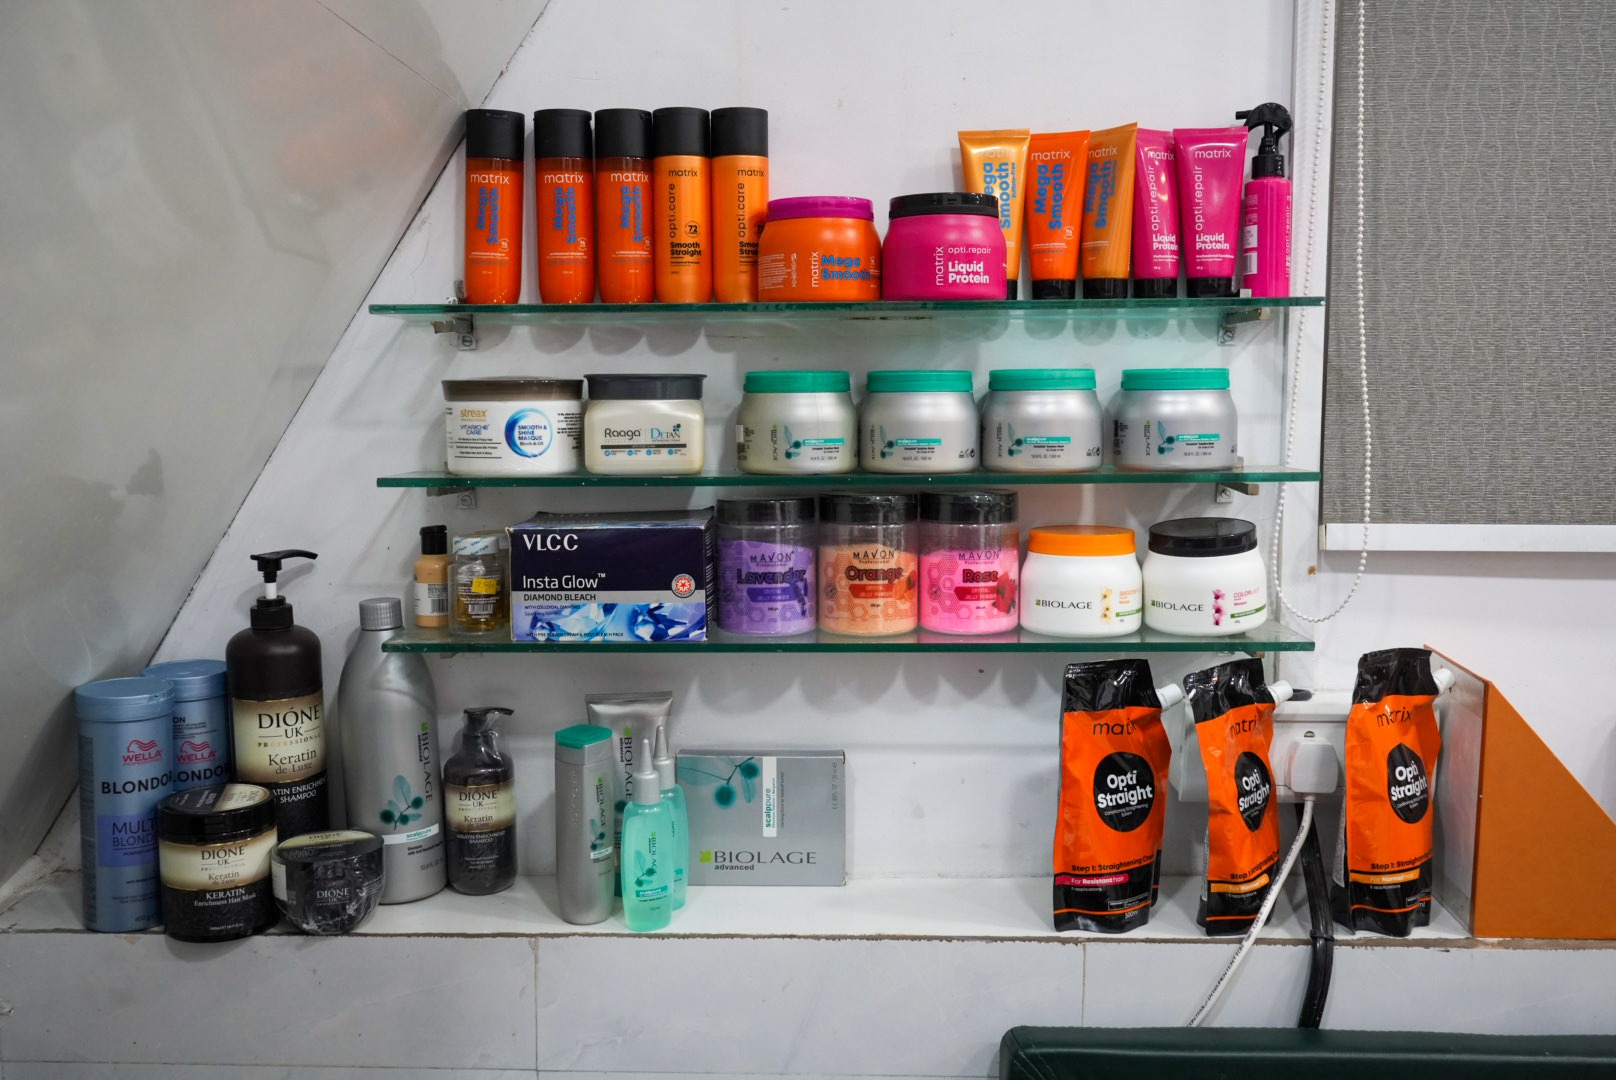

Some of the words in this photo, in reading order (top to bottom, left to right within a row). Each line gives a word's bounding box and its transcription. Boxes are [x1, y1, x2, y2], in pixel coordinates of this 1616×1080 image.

[1031, 150, 1071, 161] matrix
[1088, 146, 1118, 158] matrix
[1147, 150, 1175, 160] matrix
[1195, 149, 1231, 159] matrix
[470, 173, 510, 185] matrix
[544, 172, 584, 184] matrix
[611, 171, 649, 183] matrix
[668, 168, 698, 177] matrix
[738, 167, 765, 177] matrix
[983, 162, 998, 196] ega
[1034, 164, 1051, 214] Mega
[1085, 162, 1099, 213] Mega
[1094, 160, 1112, 228] Smooth
[996, 162, 1011, 229] Smooth
[1048, 163, 1064, 230] Smooth
[1148, 165, 1159, 231] opti.repair
[1193, 165, 1204, 231] opti.repair
[476, 187, 489, 230] Mega
[553, 187, 567, 230] Mega
[620, 186, 632, 229] Mega
[633, 185, 643, 243] Smooth
[668, 183, 677, 239] opti.care
[738, 182, 746, 238] opti.care
[488, 187, 500, 244] Smooth
[566, 187, 577, 244] Smooth
[688, 225, 698, 234] 72
[1152, 234, 1175, 243] Liquid
[1195, 233, 1224, 243] Liquid
[948, 246, 991, 256] opti.repair
[1152, 242, 1178, 250] Protein
[1195, 241, 1229, 250] Protein
[670, 249, 702, 257] Straight
[811, 251, 819, 287] matrix
[821, 255, 861, 269] Mega
[936, 246, 944, 286] matrix
[948, 261, 984, 274] Liquid
[821, 268, 871, 281] Smooth
[948, 273, 990, 284] Protein
[460, 408, 487, 418] streax
[604, 428, 641, 441] Raaga
[522, 533, 579, 551] VLCC
[750, 552, 792, 562] MAVON
[853, 548, 895, 559] MAVON
[959, 550, 1000, 560] MAVON
[736, 567, 806, 585] Lavender
[845, 565, 903, 584] Orange
[962, 568, 999, 583] Rose
[523, 575, 559, 589] Insta
[523, 593, 562, 602] DIAMOND
[564, 593, 597, 601] BLEACH
[1041, 599, 1092, 609] BIOLAGE
[1155, 600, 1205, 612] BIOLAGE
[257, 704, 321, 729] DIÓNE
[284, 726, 303, 739] UK
[258, 732, 321, 748] PROFESSIONAL
[122, 750, 162, 763] WELLA
[176, 751, 216, 763] WELLA
[268, 749, 317, 766] Keratin
[275, 765, 287, 775] de
[292, 762, 313, 773] Luxe
[421, 732, 433, 803] BIOLAGE
[623, 737, 634, 800] BIOLAGE
[1395, 760, 1419, 782] Opti
[1106, 769, 1137, 791] Opti
[1242, 769, 1260, 791] Opti
[1390, 776, 1428, 801] Straight
[279, 789, 317, 804] SHAMPOO
[1097, 784, 1153, 808] Straight
[1238, 782, 1270, 812] Straight
[598, 783, 606, 826] BIOLAGE
[464, 814, 493, 824] Keratin
[406, 828, 432, 839] scalppure
[714, 851, 817, 864] BIOLAGE
[1071, 865, 1092, 873] Step
[1098, 857, 1142, 871] Straightening
[208, 870, 240, 881] Keratin
[1230, 873, 1248, 881] Step
[194, 899, 227, 907] Enrichment
[242, 892, 257, 902] Mask
[206, 888, 245, 900] KERATIN
